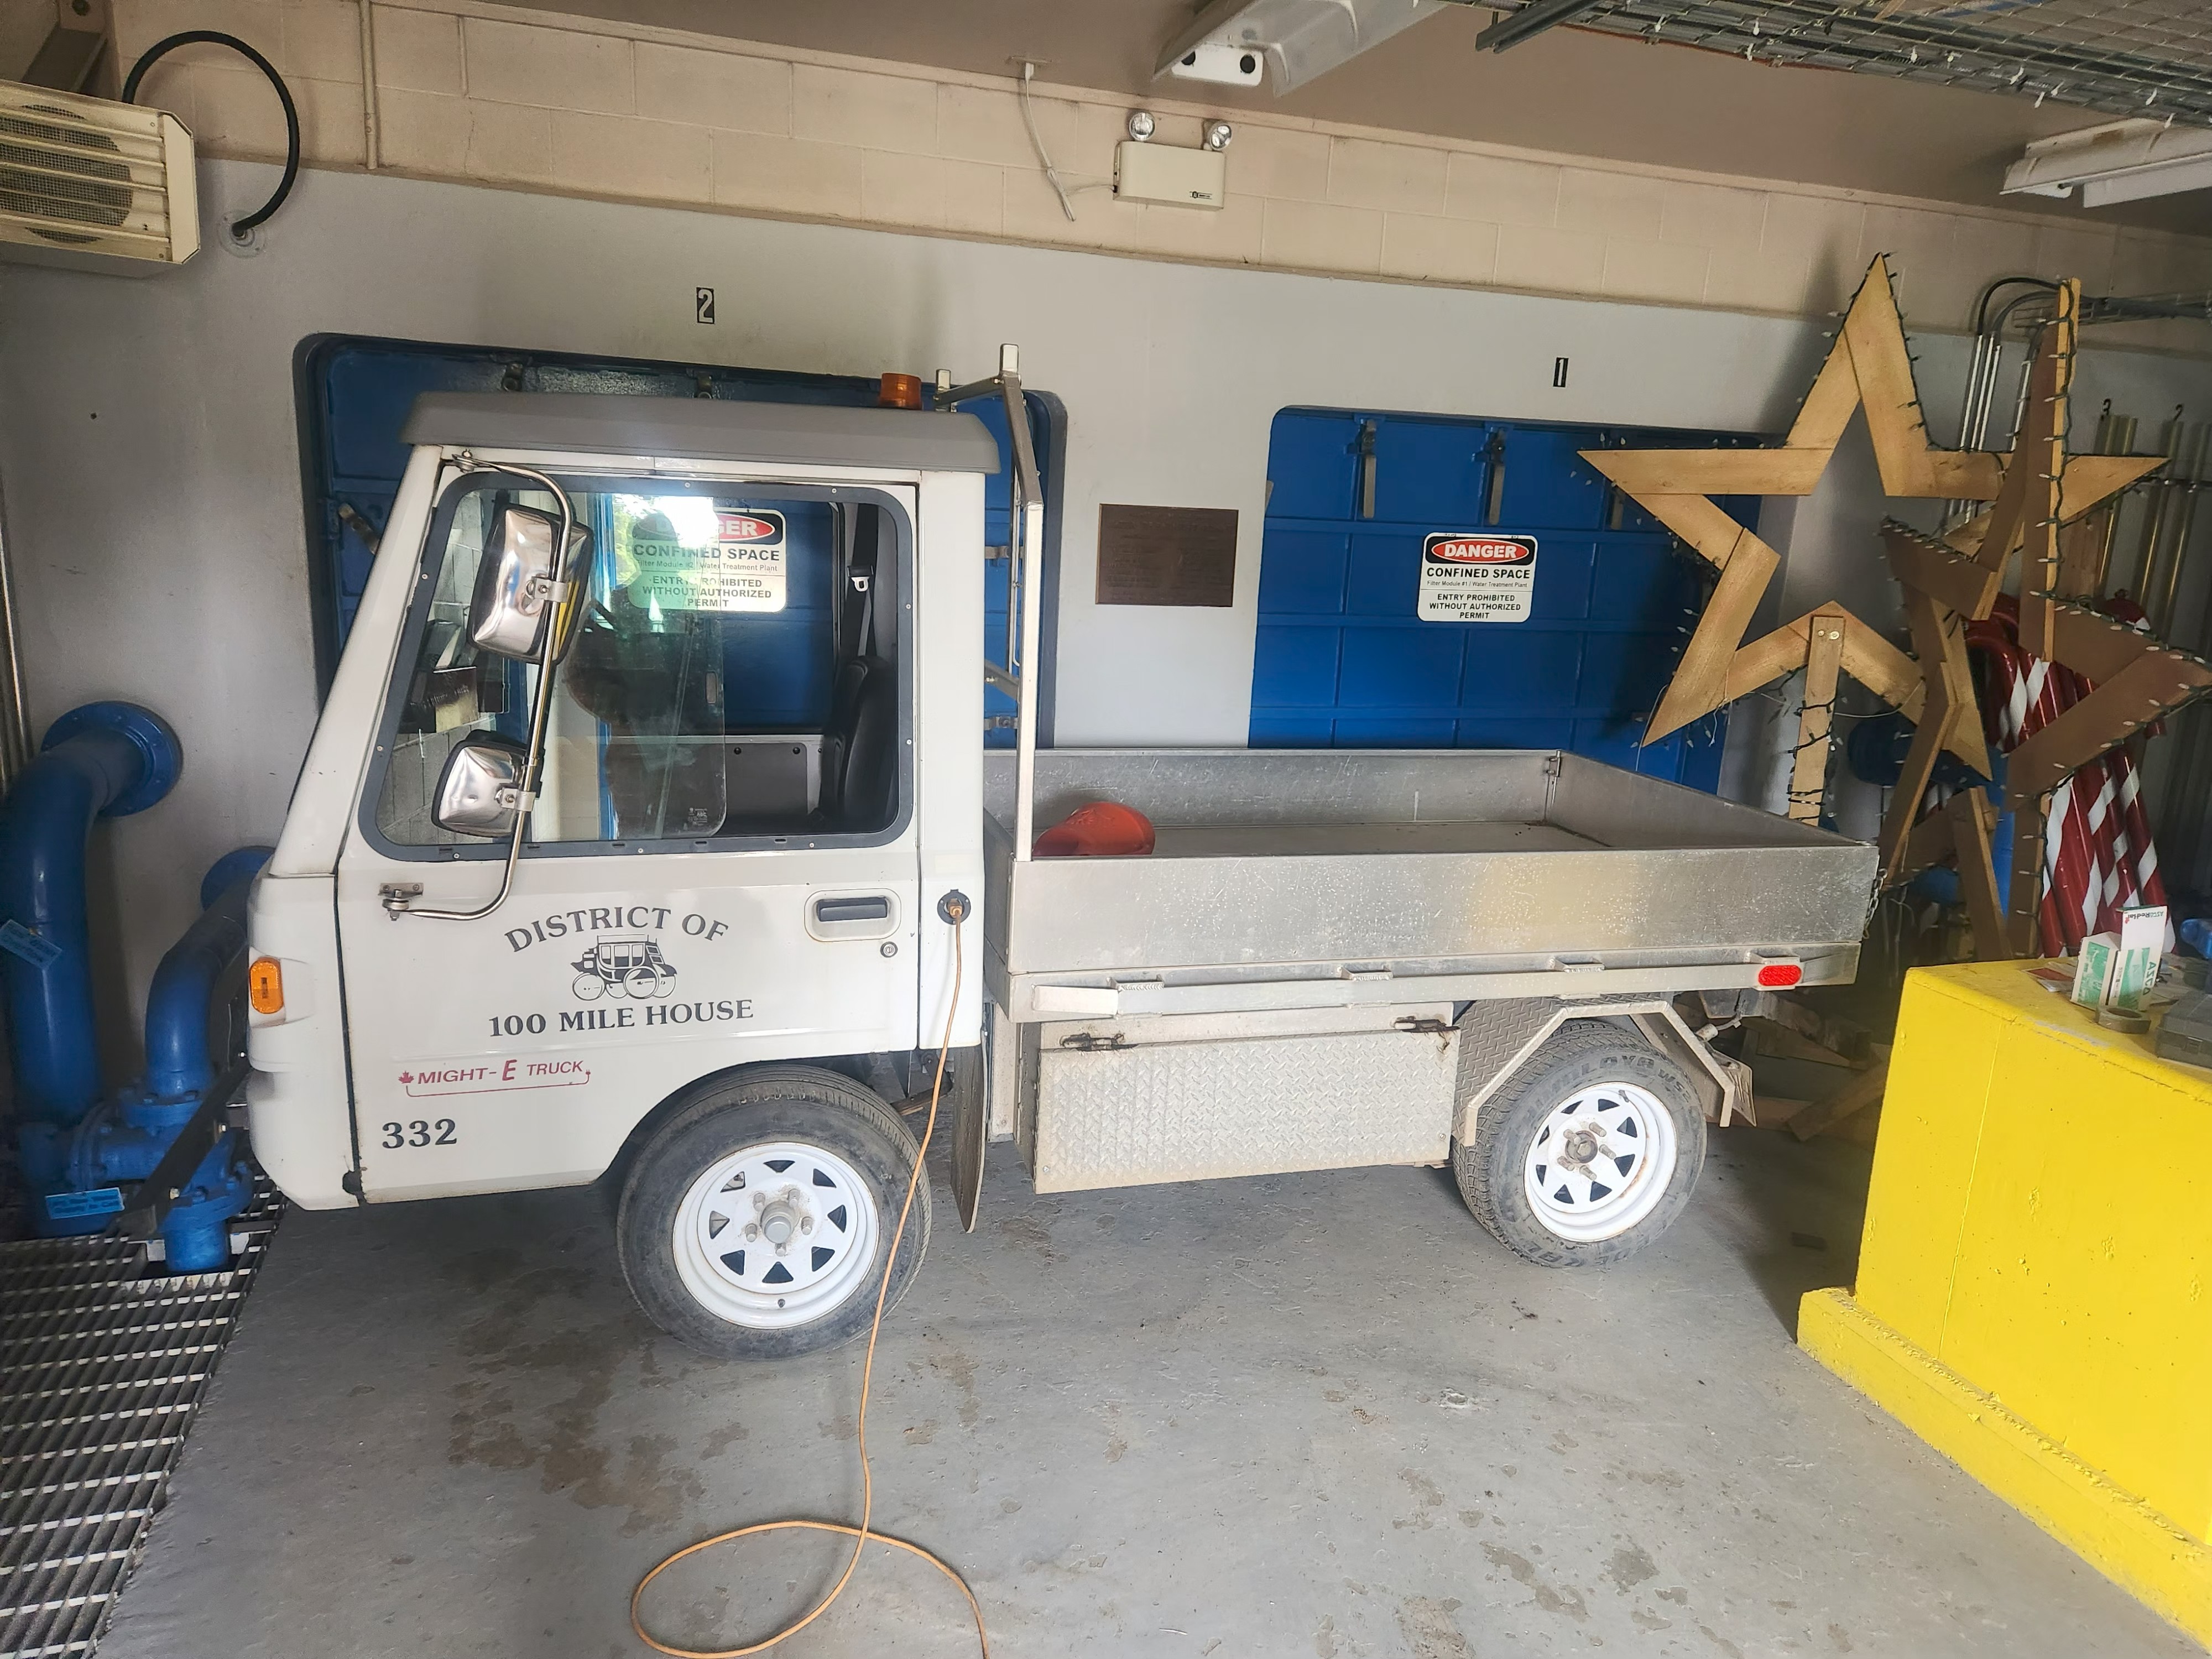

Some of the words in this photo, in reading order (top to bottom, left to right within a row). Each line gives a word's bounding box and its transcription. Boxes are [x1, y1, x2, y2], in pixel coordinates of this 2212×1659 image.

[697, 288, 713, 323] 2
[1556, 358, 1566, 387] 1
[634, 544, 721, 559] CONFINED
[727, 549, 780, 561] SPACE
[1444, 544, 1517, 558] DANGER
[653, 576, 690, 585] ENTR
[694, 577, 762, 587] ROHIBITED
[1427, 567, 1489, 578] CONFINED
[1493, 569, 1530, 579] SPACE
[642, 586, 696, 596] WITHOUT
[700, 588, 771, 598] AUTHORIZED
[504, 906, 671, 952] DISTRICT
[681, 913, 729, 941] OF
[489, 1014, 546, 1037] 100
[559, 1008, 635, 1032] MILE
[645, 999, 754, 1026] HOUSE
[526, 1060, 585, 1076] TRUCK
[382, 1118, 457, 1149] 332
